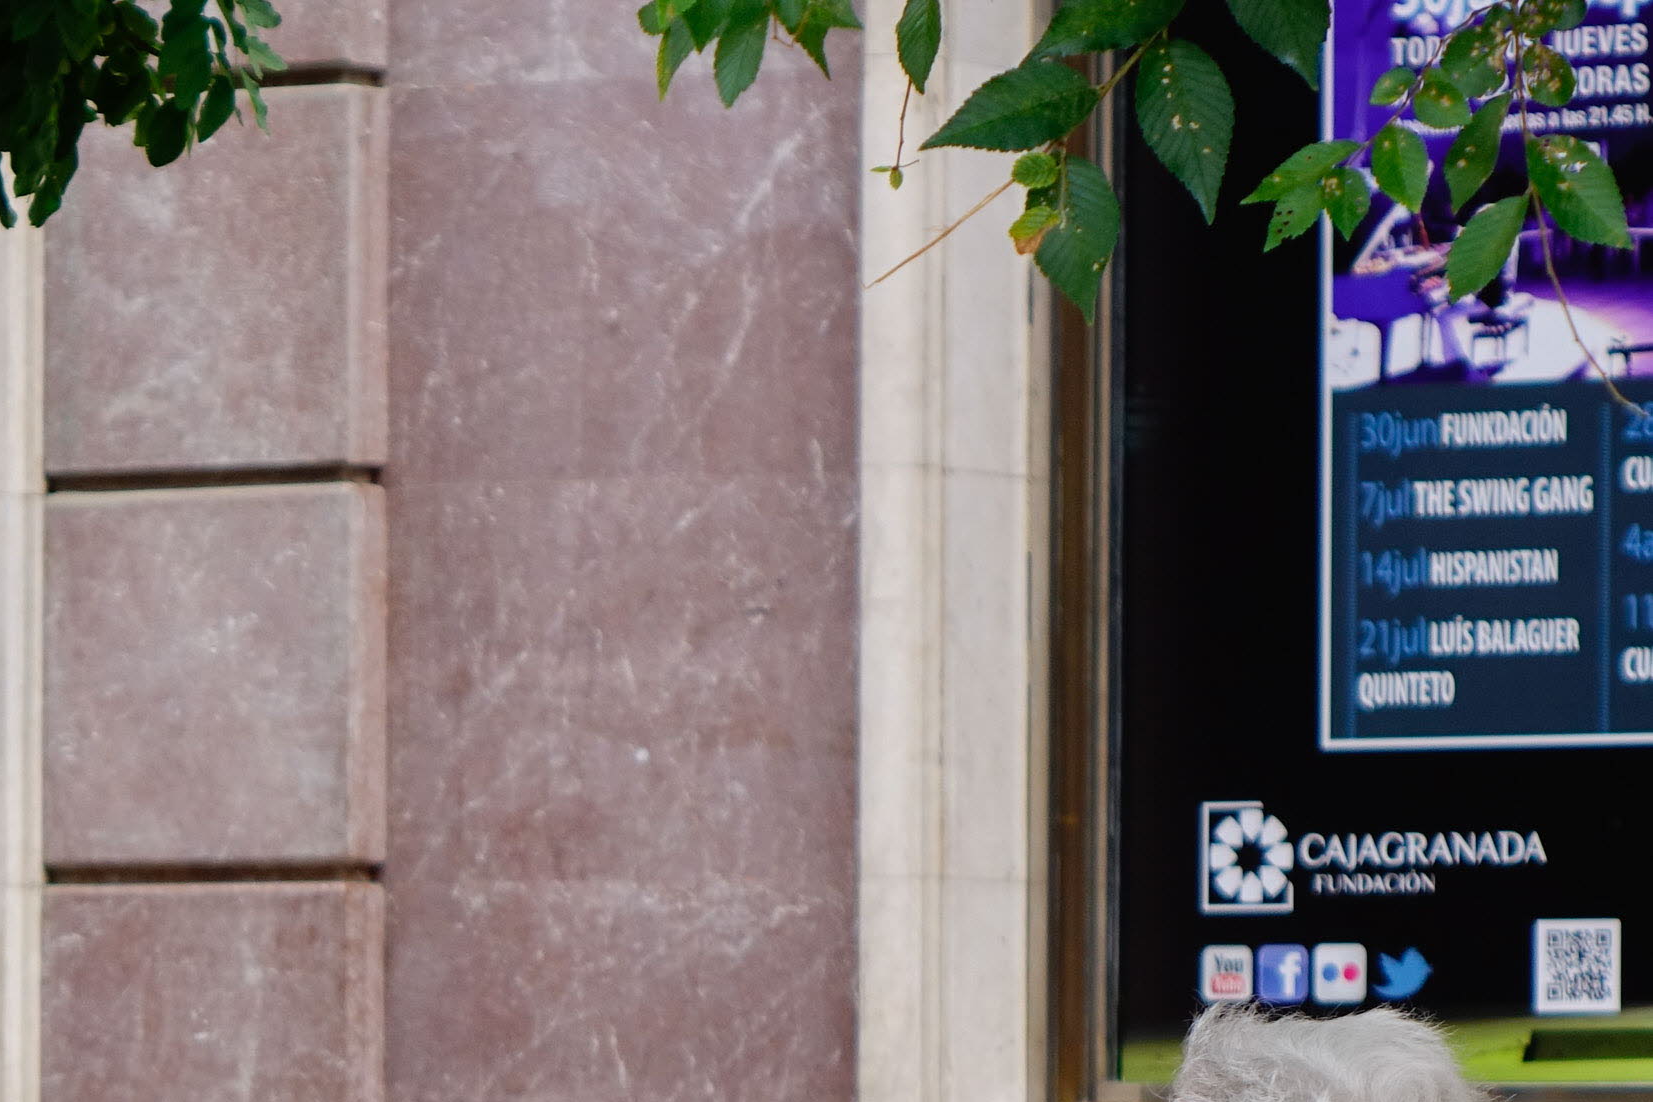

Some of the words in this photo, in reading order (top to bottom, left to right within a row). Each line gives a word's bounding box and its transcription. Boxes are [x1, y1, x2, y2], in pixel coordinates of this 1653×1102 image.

[1572, 62, 1651, 97] ORAS
[1361, 411, 1439, 457] 30jun
[1440, 403, 1568, 446] FUNKDACIÓN
[1361, 478, 1412, 528] 7jul
[1412, 480, 1456, 516] THE
[1458, 478, 1530, 515] SWING
[1532, 475, 1594, 513] GANG
[1362, 547, 1428, 597] 14jul
[1429, 548, 1559, 586] HISPANISTAN
[1360, 616, 1428, 664] 21jul
[1475, 617, 1580, 655] BALAGUER
[1358, 670, 1456, 709] QUINTETO
[1299, 830, 1548, 872] CAJAGRANADA
[1312, 868, 1436, 895] FUNDACIÓN
